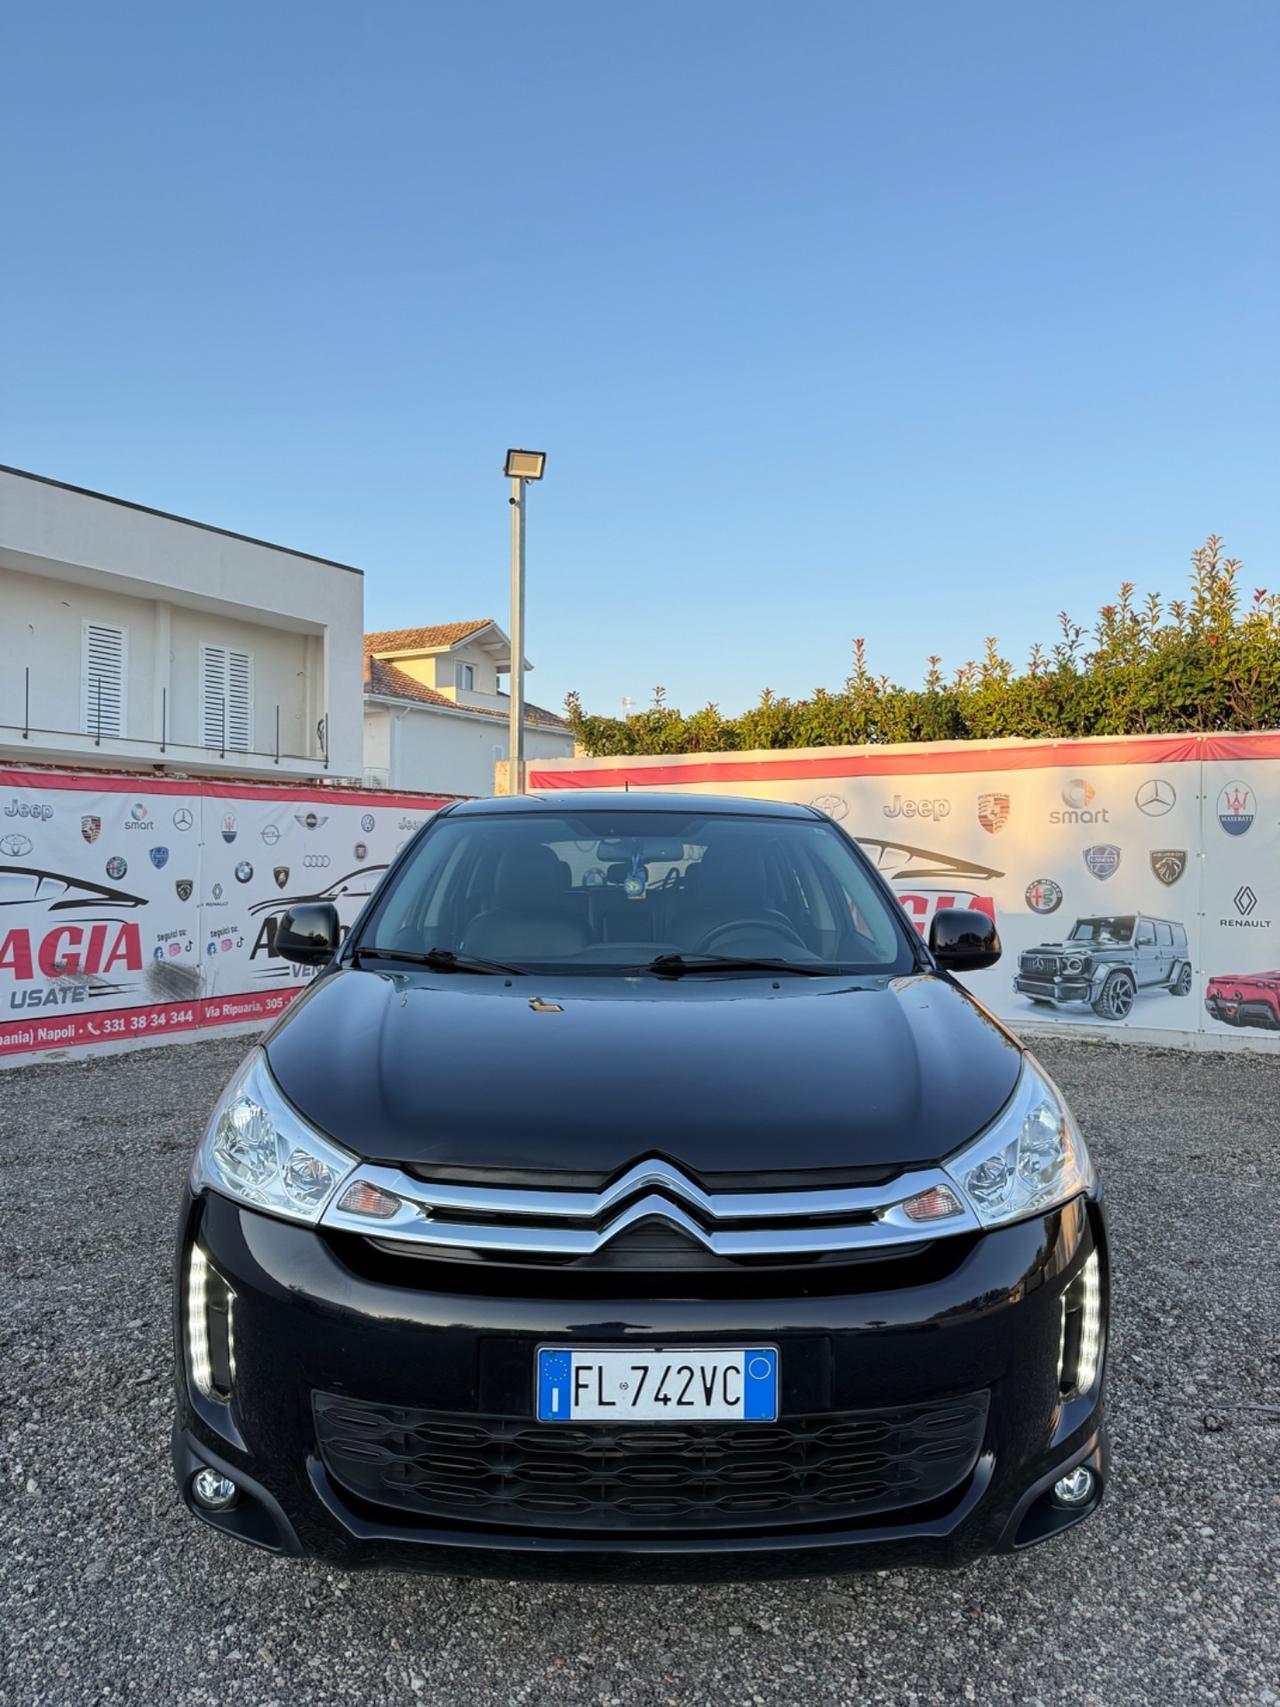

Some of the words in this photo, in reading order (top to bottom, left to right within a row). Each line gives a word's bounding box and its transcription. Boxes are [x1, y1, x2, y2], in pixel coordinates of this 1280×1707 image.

[4, 799, 54, 821] Jeep
[883, 794, 951, 822] Jeep
[1048, 808, 1110, 825] smart
[124, 820, 154, 830] smart
[1220, 919, 1272, 929] RENAULT
[10, 985, 87, 1009] USATE
[205, 1005, 220, 1018] Via
[222, 1001, 264, 1017] Ripuaria,
[266, 997, 284, 1010] 305
[38, 1024, 75, 1042] Napoli
[103, 1018, 126, 1034] 331
[130, 1015, 148, 1030] 38
[151, 1013, 167, 1027] 34
[170, 1009, 194, 1024] 344
